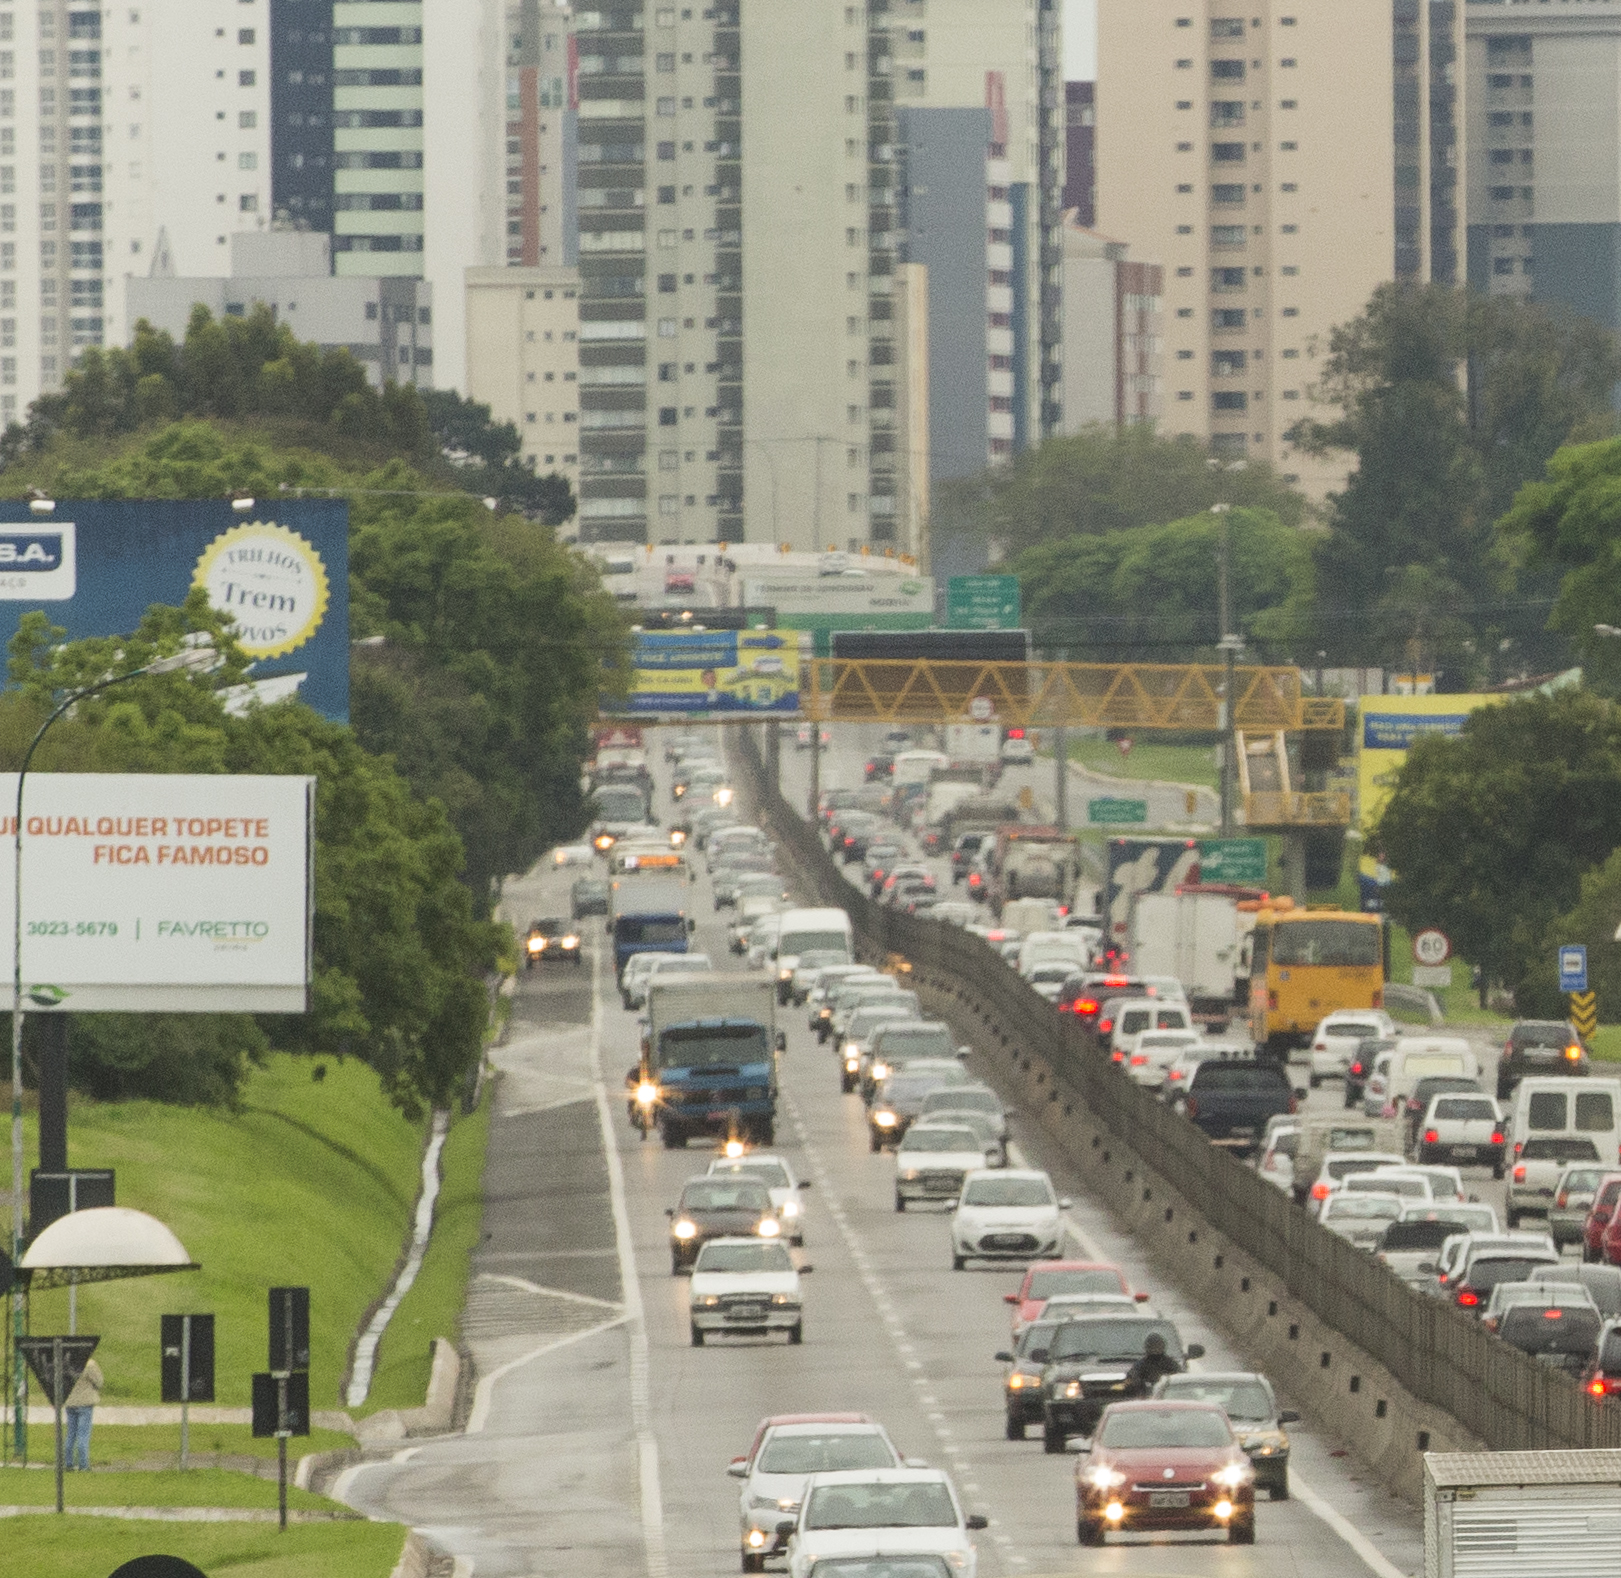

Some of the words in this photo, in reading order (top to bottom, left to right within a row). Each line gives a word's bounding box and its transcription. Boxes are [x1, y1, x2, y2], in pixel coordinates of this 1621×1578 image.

[227, 548, 303, 574] TRILHOS
[221, 581, 297, 613] Trem
[235, 621, 288, 642] OVOS
[27, 816, 168, 837] QUALQUER
[173, 817, 270, 838] TOPETE
[92, 844, 151, 865] FICA
[157, 845, 270, 866] FAMOSO
[27, 920, 118, 937] 3023-5679
[157, 920, 270, 938] FAVRETTO
